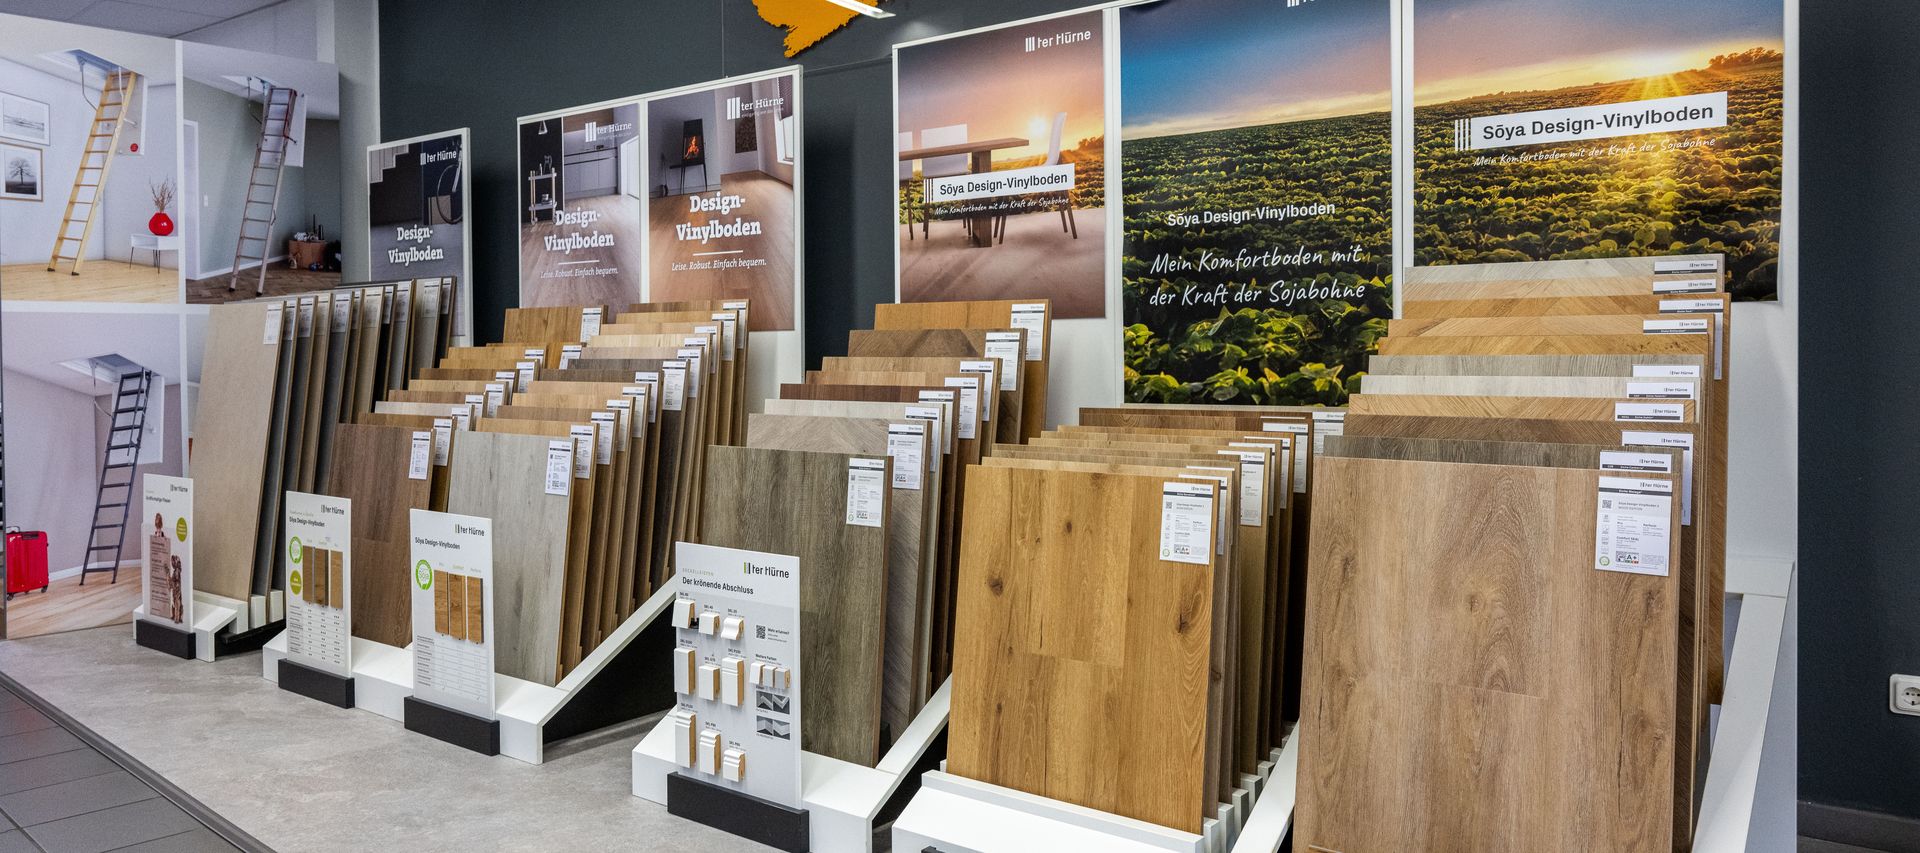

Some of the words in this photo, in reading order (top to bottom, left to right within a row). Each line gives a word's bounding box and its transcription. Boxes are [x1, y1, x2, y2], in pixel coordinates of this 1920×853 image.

[1037, 38, 1052, 48] ter
[741, 102, 754, 111] ter
[755, 96, 784, 108] Hürne
[597, 126, 608, 135] ter
[609, 122, 632, 134] Hürne
[1532, 104, 1714, 136] Design-Vinylboden
[427, 154, 436, 163] ter
[1473, 156, 1498, 167] Mein
[1499, 150, 1568, 167] Komfortboden
[1569, 148, 1587, 159] mit
[1588, 146, 1604, 157] der
[1608, 143, 1637, 156] Kraft
[1639, 141, 1656, 152] der
[1660, 136, 1716, 153] Sojabohne
[967, 172, 1068, 193] Design-Vinylboden
[690, 191, 746, 215] Design-
[934, 206, 949, 216] Mein
[950, 205, 987, 215] Komfortboden
[988, 203, 999, 211] mit
[999, 202, 1009, 210] der
[1010, 200, 1026, 209] Kraft
[1027, 199, 1038, 208] der
[1038, 196, 1069, 209] Sojabohne
[555, 206, 601, 228] Design-
[1204, 203, 1336, 225] Design-Vinylboden
[397, 224, 433, 243] Design-
[676, 218, 762, 244] Vinylboden
[544, 231, 614, 254] Vinylboden
[388, 245, 444, 266] Vinylboden
[672, 262, 688, 272] Leise.
[689, 261, 712, 271] Robust.
[712, 258, 738, 272] Einfach
[738, 258, 767, 270] bequem.
[1150, 252, 1192, 274] Mein
[1198, 245, 1323, 276] Komfortboden
[1331, 244, 1363, 263] mit
[1150, 287, 1176, 306] der
[1181, 284, 1228, 306] Kraft
[1234, 282, 1262, 303] der
[1269, 278, 1366, 307] Sojabohne
[460, 526, 468, 534] ter
[752, 564, 764, 576] ter
[682, 576, 693, 584] Der
[694, 578, 722, 590] krönende
[722, 583, 754, 594] Abschluss
